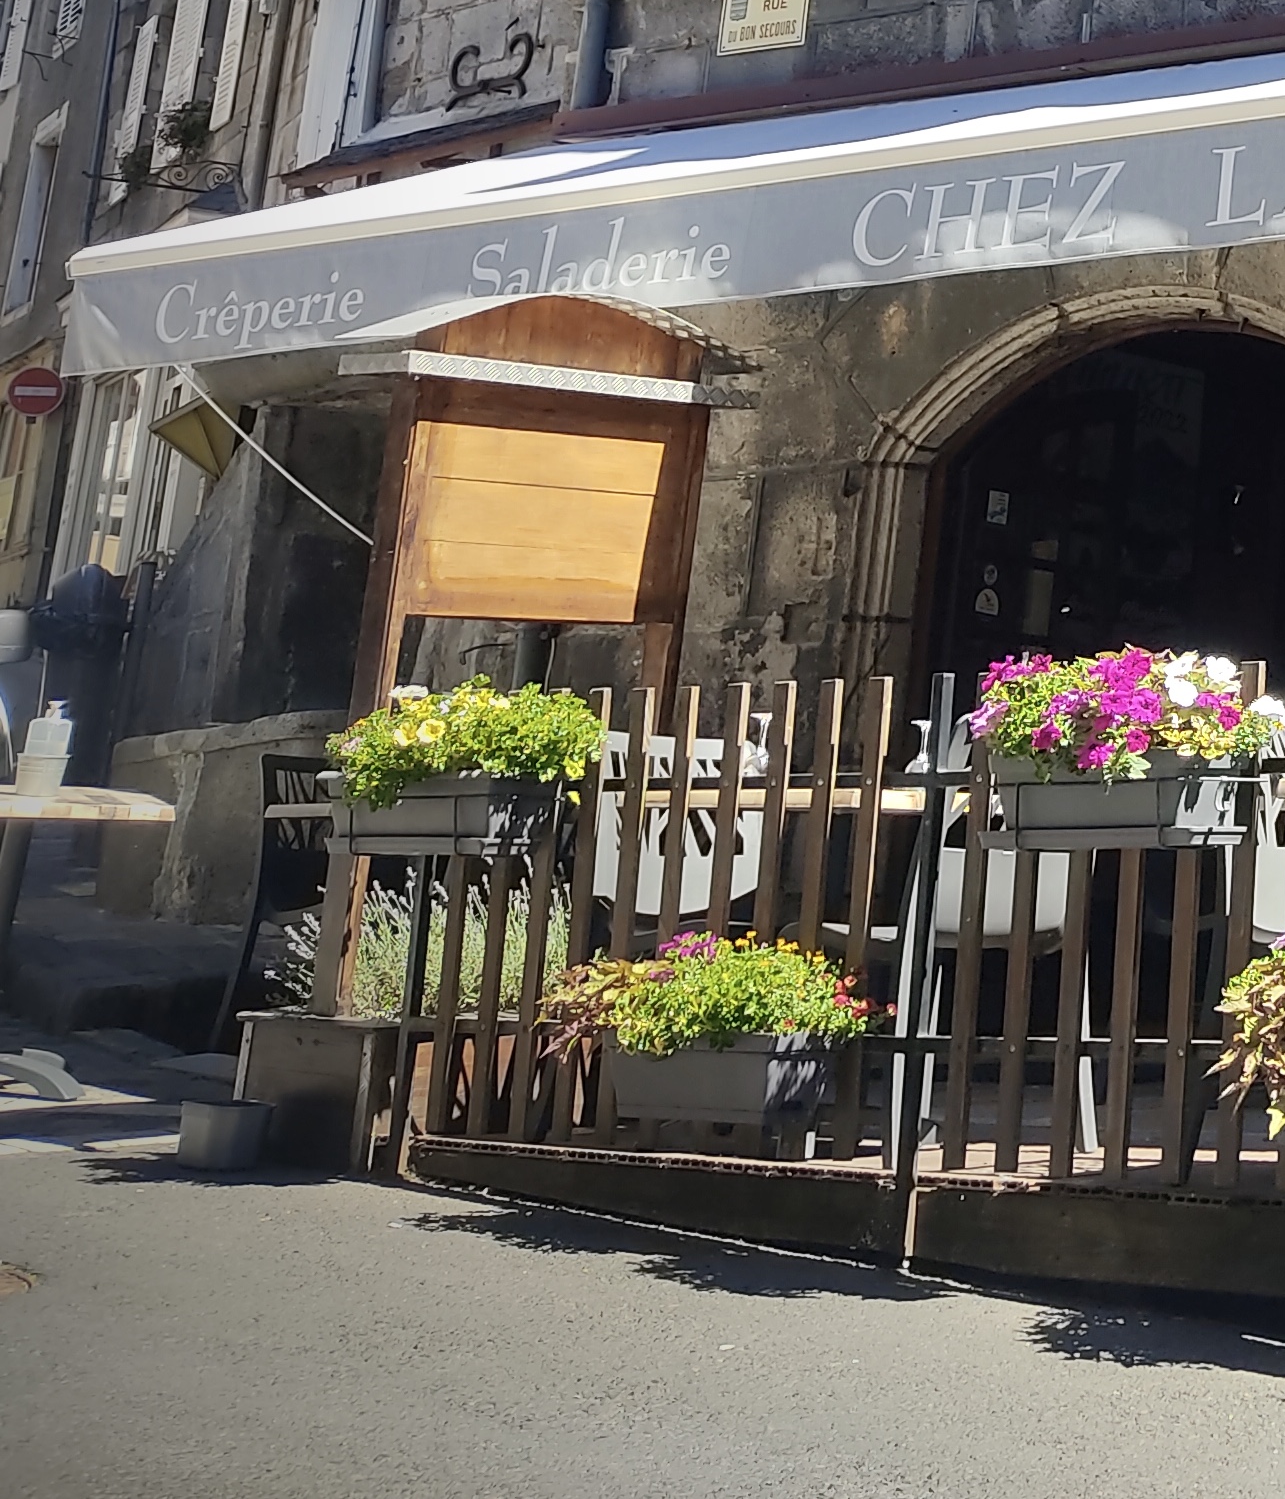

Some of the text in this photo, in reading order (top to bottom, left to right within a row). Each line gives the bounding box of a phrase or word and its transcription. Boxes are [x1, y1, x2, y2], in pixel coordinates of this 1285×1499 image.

[739, 25, 756, 41] BON
[759, 19, 797, 39] SECOURS
[155, 271, 365, 350] Crêperie
[466, 216, 731, 297] Saladerie
[852, 159, 1127, 267] CHEZ
